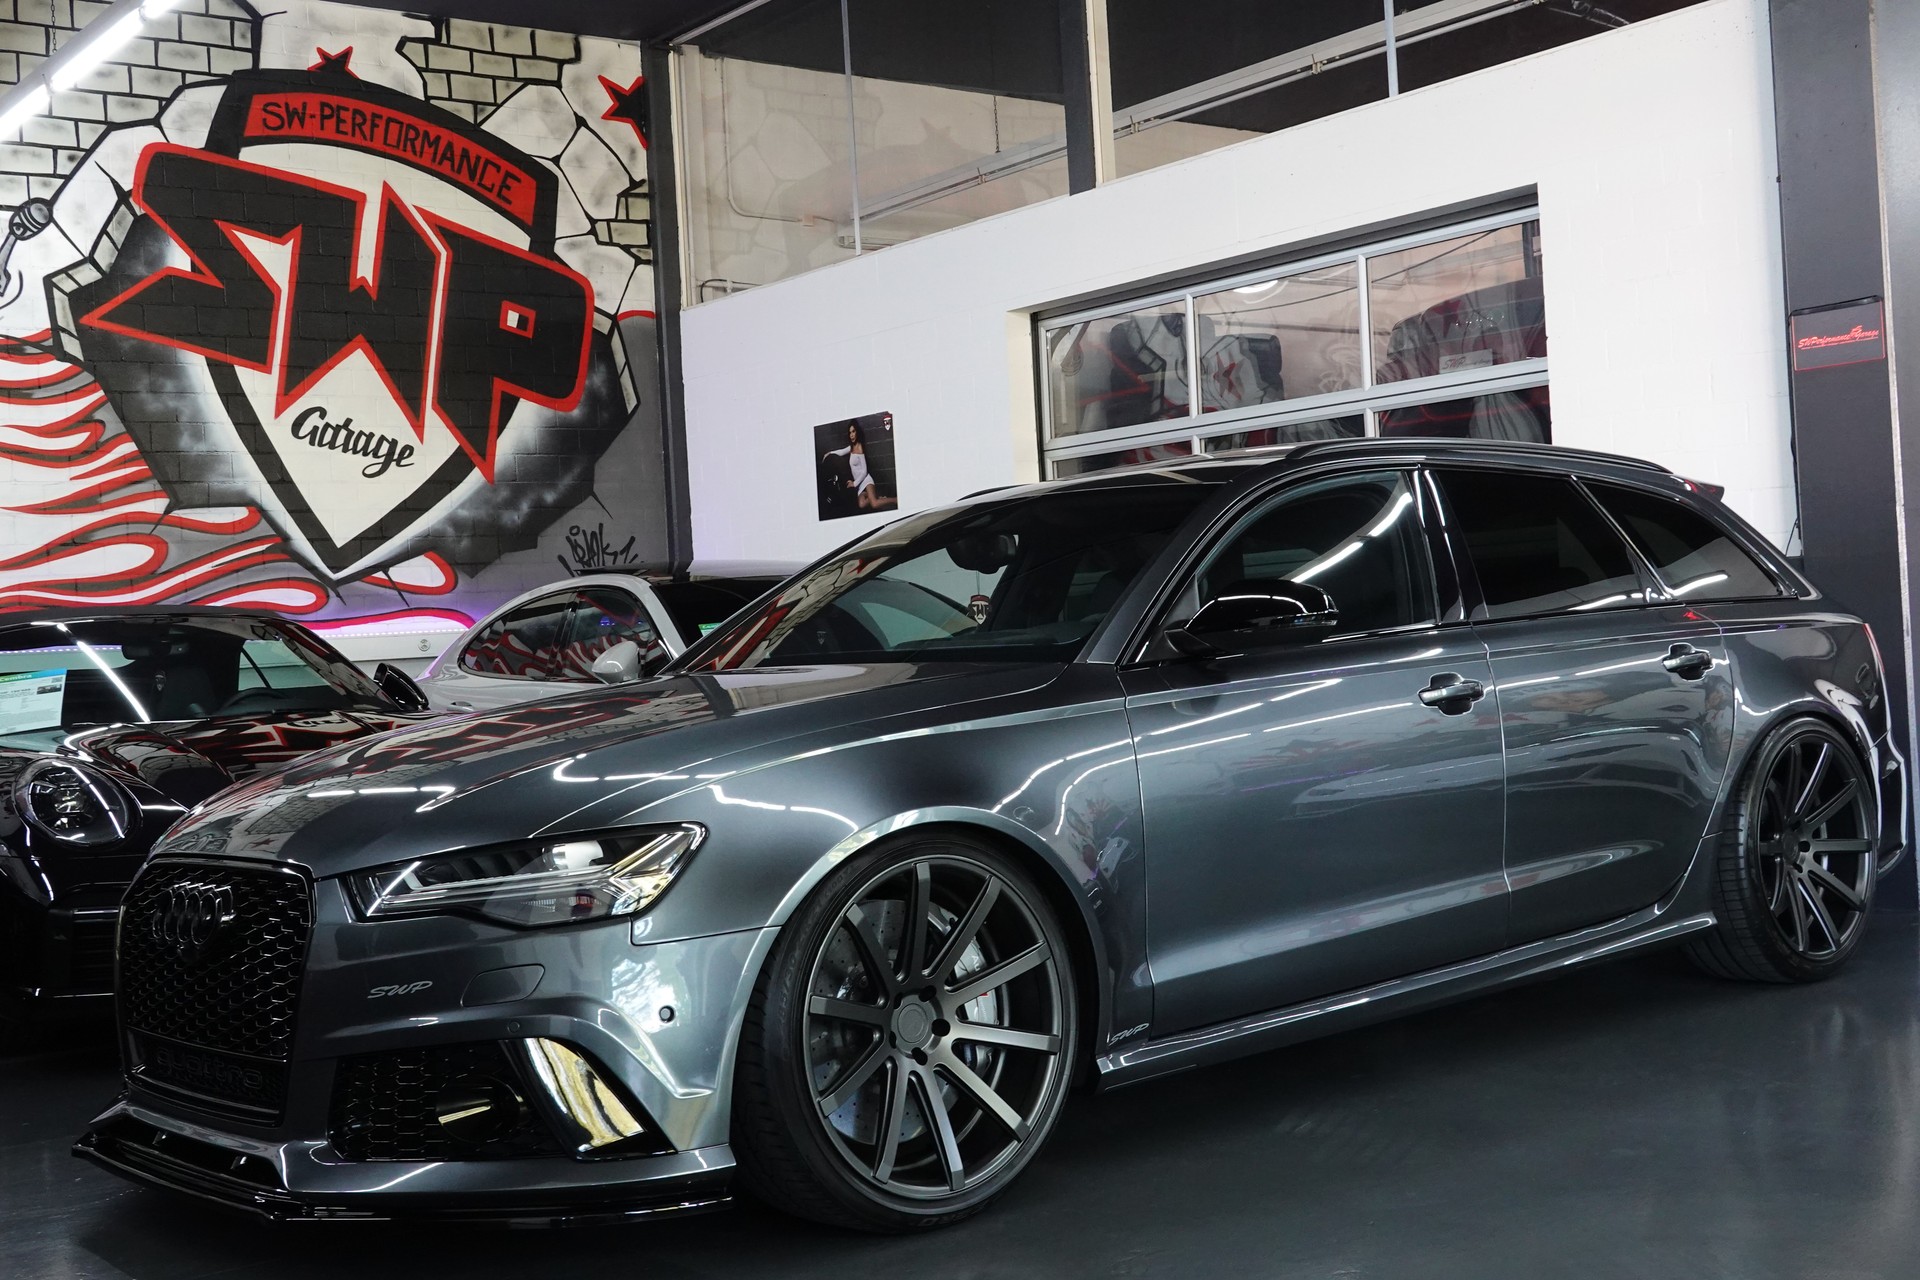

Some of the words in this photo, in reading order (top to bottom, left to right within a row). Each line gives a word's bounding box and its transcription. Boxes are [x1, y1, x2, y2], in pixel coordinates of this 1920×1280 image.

[261, 101, 522, 205] SW-PERFORMANCE
[291, 406, 415, 478] Garage
[367, 980, 433, 999] SWP
